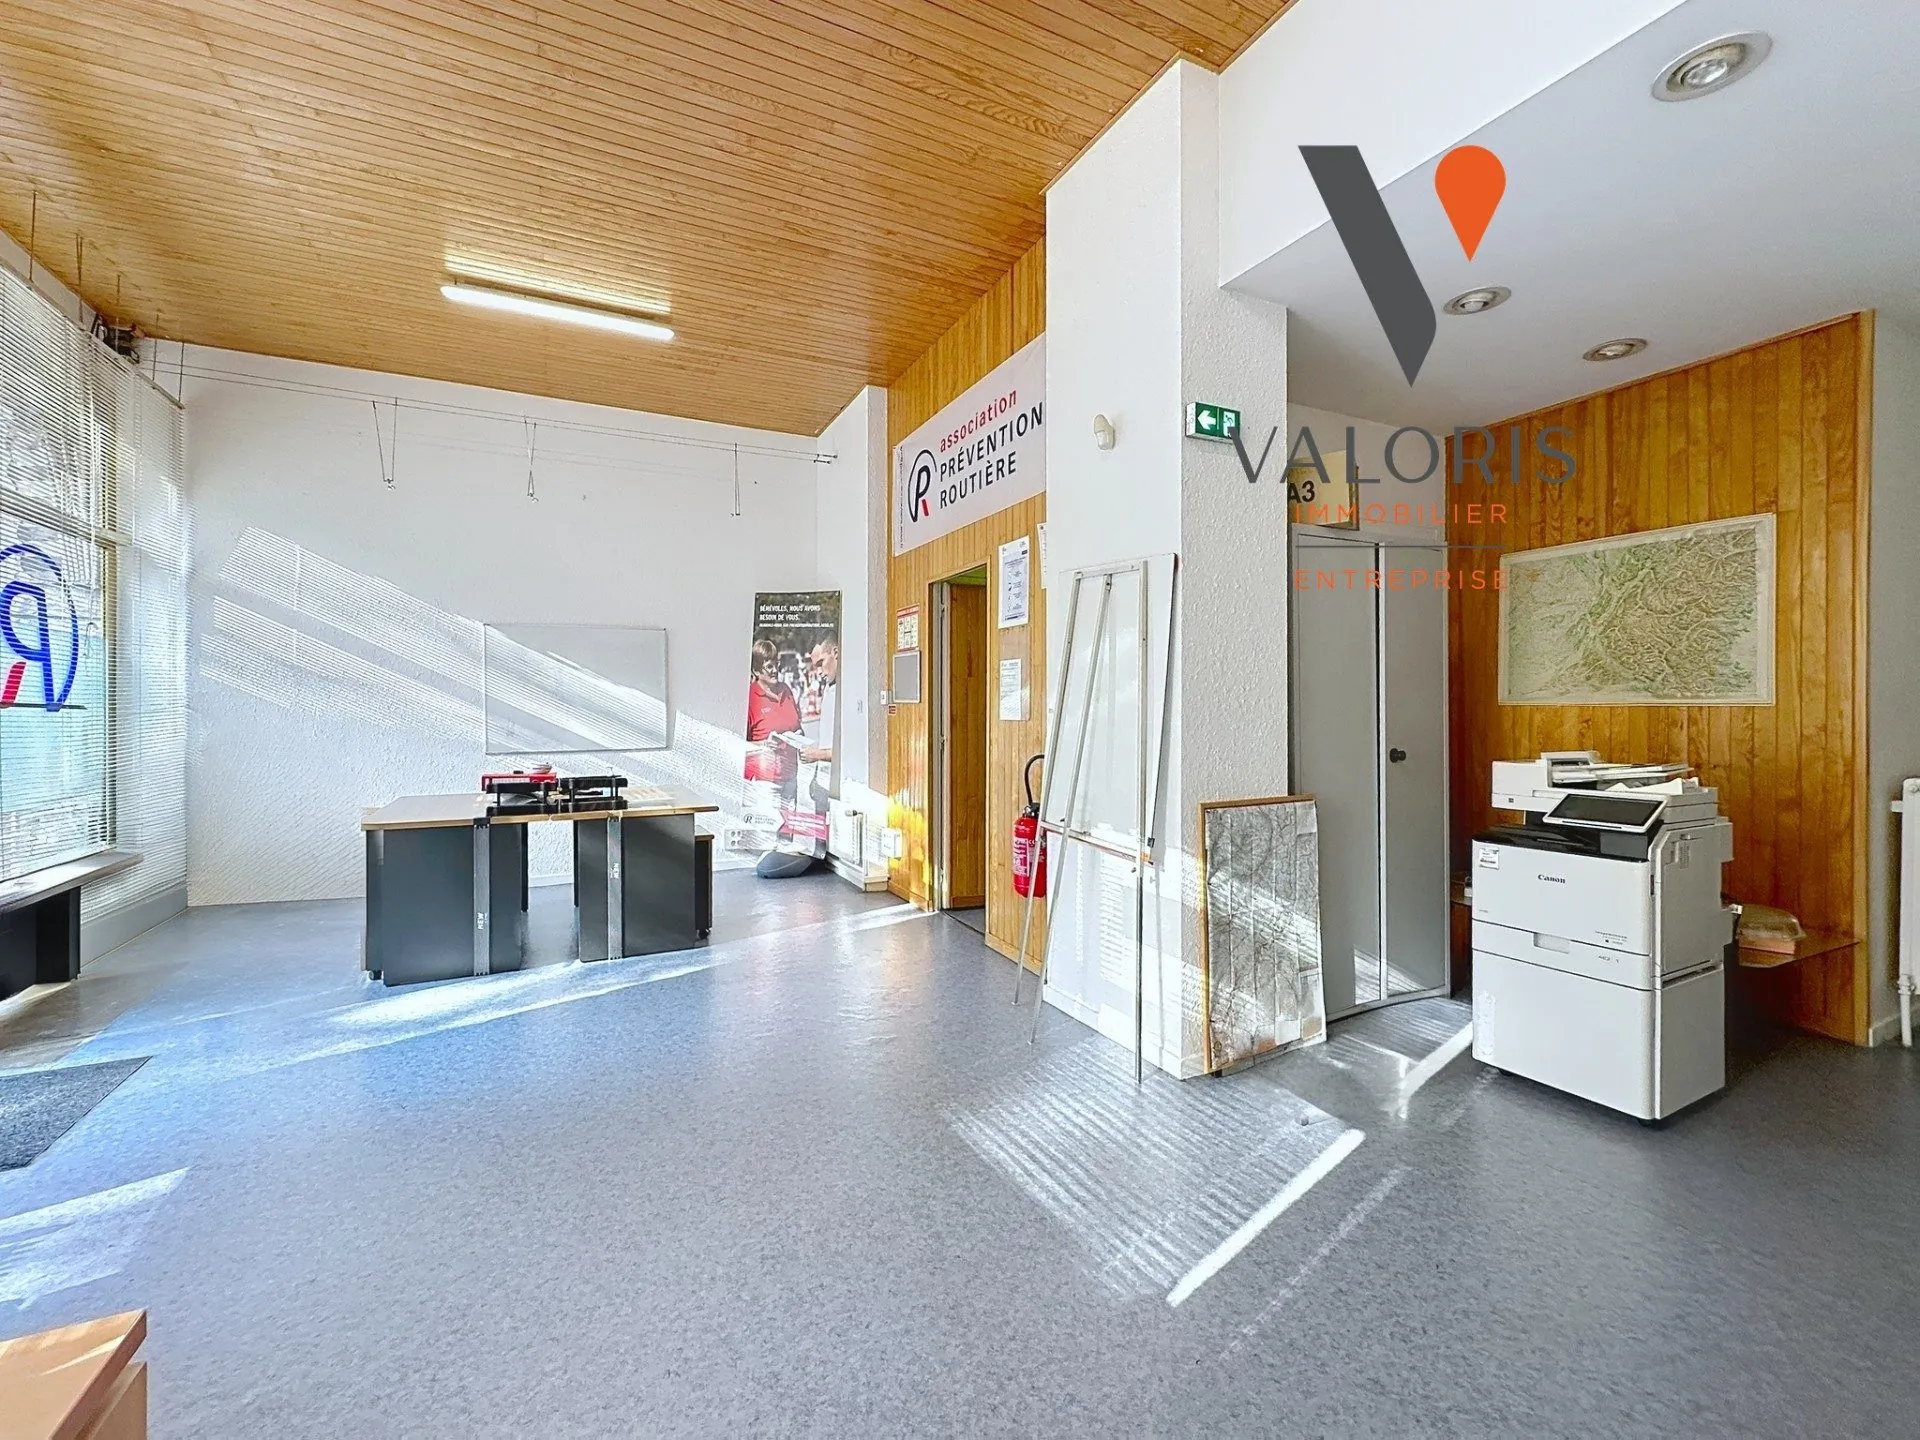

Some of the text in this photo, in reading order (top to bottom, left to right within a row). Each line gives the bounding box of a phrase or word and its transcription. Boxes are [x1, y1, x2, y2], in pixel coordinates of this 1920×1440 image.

[939, 389, 1018, 453] association
[940, 401, 1044, 483] PRÉVENTION
[939, 450, 1017, 509] ROUTIÈRE
[1537, 874, 1566, 884] Canon
